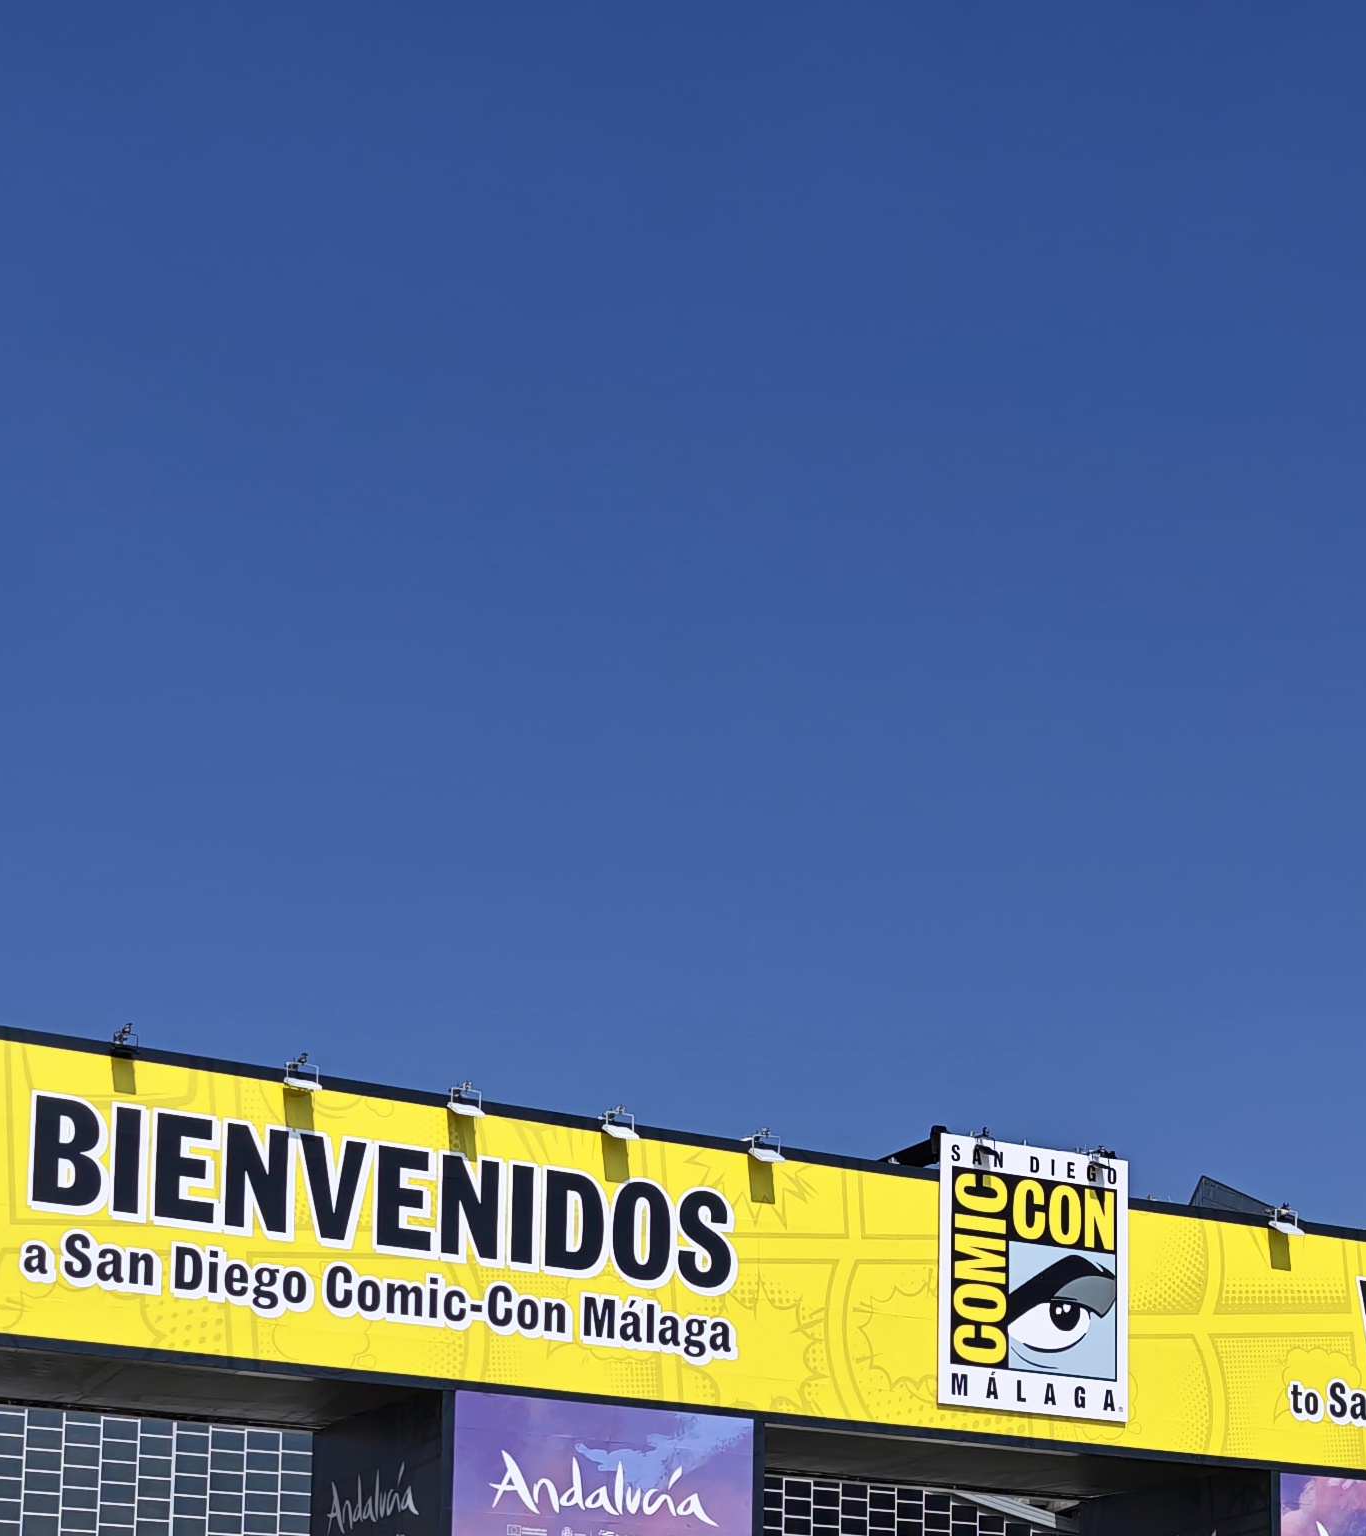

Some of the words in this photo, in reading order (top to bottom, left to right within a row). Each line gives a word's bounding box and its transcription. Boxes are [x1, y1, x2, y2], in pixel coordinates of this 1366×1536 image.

[33, 1094, 734, 1290] BIENVENIDOS
[951, 1144, 1005, 1169] SAN
[1029, 1155, 1118, 1185] DIEGO
[1012, 1179, 1115, 1251] CON
[24, 1244, 48, 1275] a
[64, 1234, 155, 1287] San
[173, 1245, 309, 1310] Diego
[325, 1265, 567, 1335] Comic-Con
[583, 1295, 733, 1356] Málaga
[953, 1172, 1008, 1365] COMIC
[951, 1371, 1117, 1413] MÁLAGA
[1290, 1384, 1317, 1416] to
[326, 1460, 420, 1536] Andalucía
[489, 1449, 720, 1528] Andalucía
